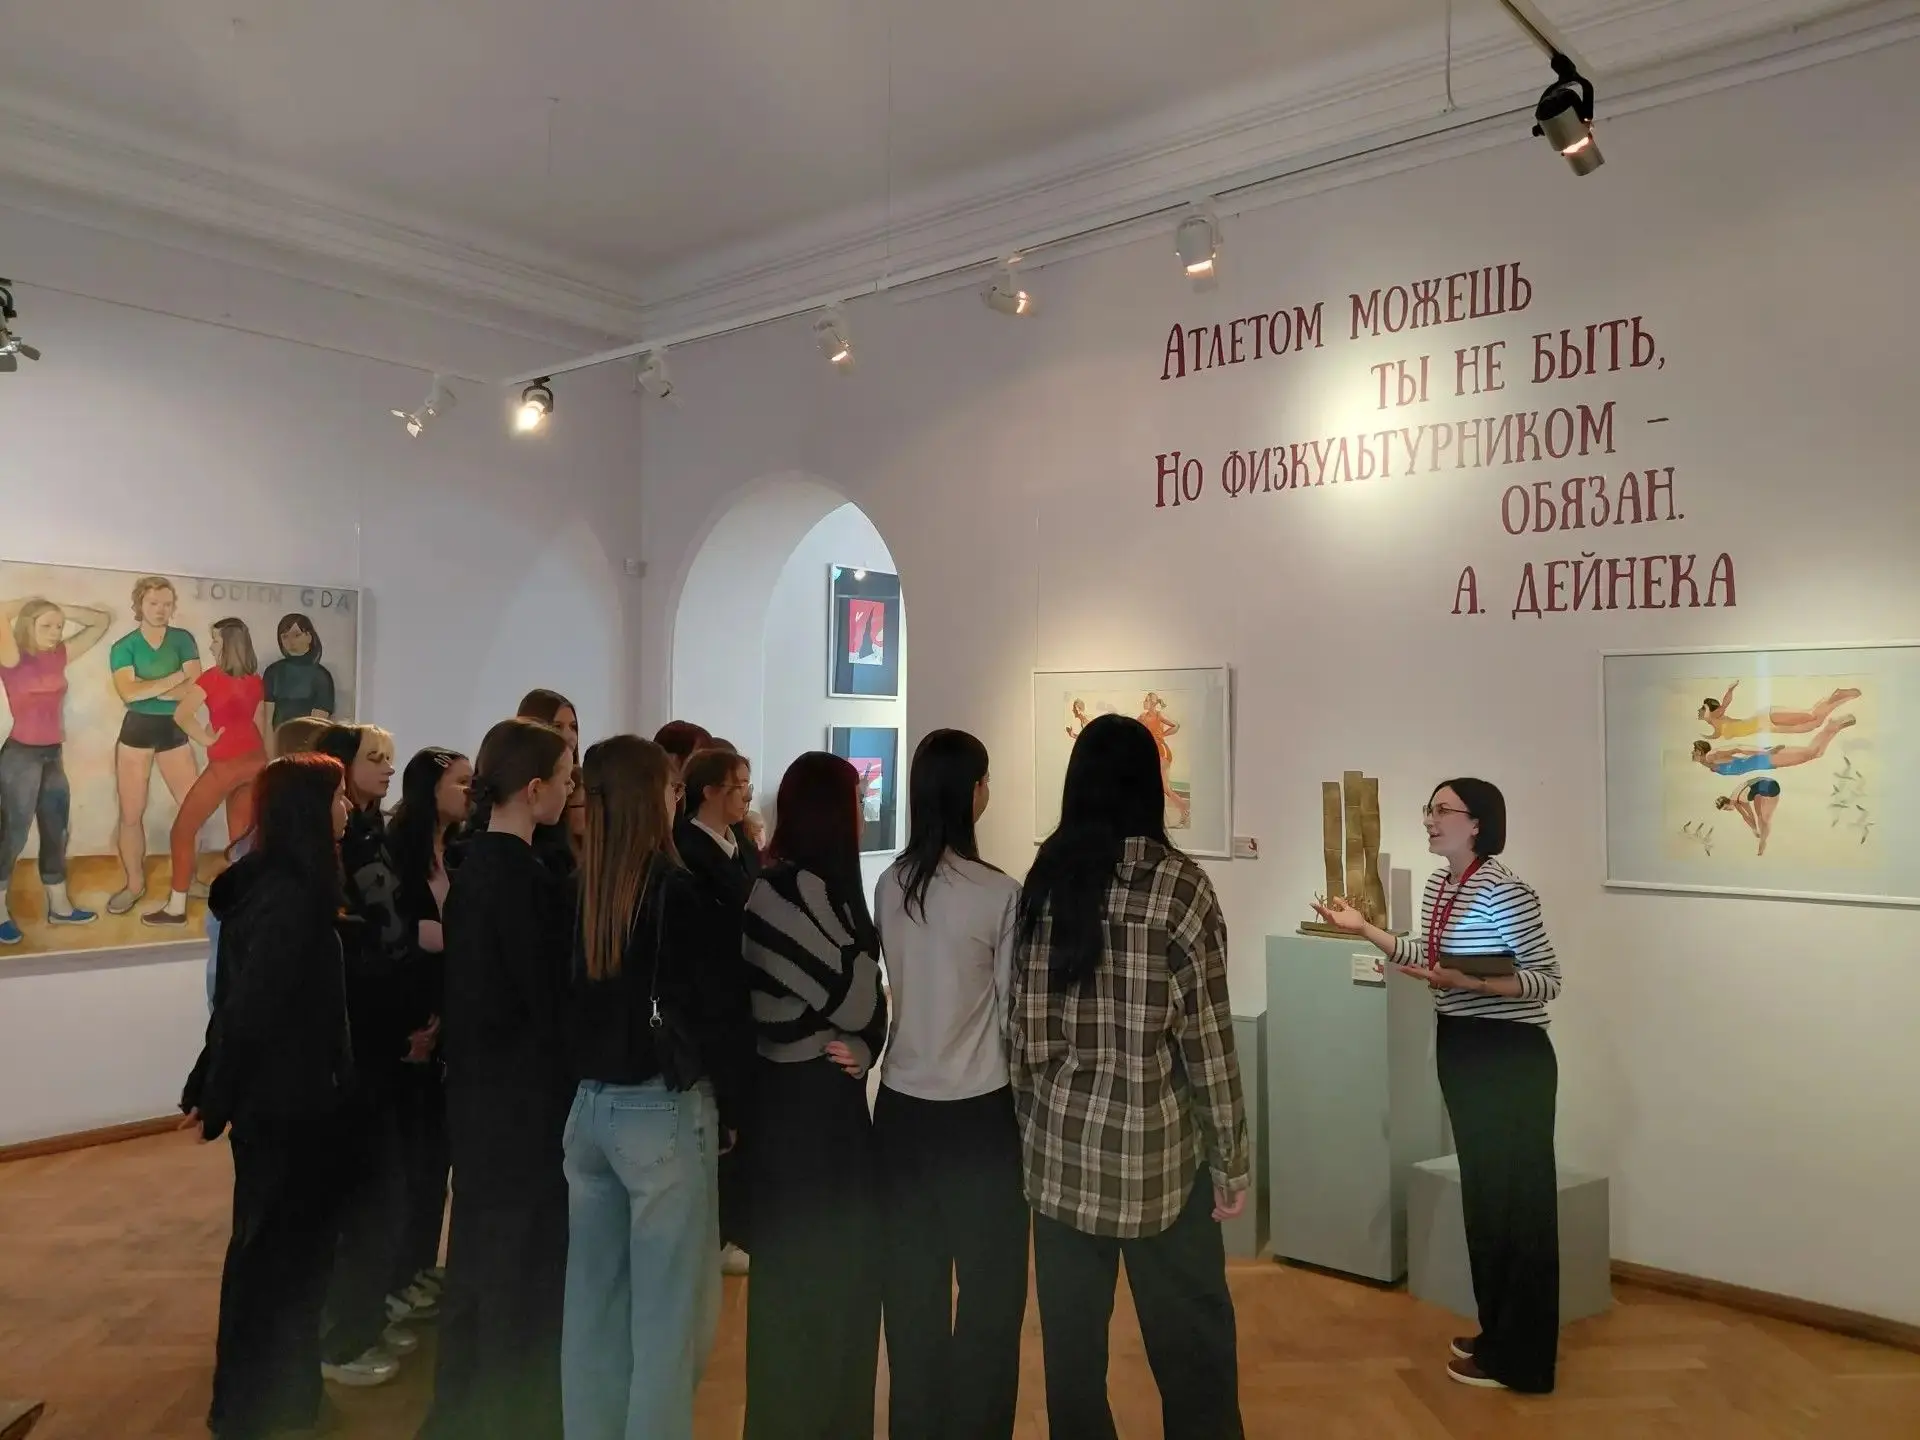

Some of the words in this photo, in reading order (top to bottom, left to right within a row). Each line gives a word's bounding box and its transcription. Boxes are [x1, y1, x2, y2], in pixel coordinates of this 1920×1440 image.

[1160, 302, 1324, 380] АТЛЕТОМ
[1349, 262, 1532, 340] МОЖЕШЬ
[1371, 355, 1430, 410] ТЫ
[1454, 341, 1506, 397] НЕ
[1531, 316, 1666, 384] БЫТЬ,
[1155, 451, 1204, 508] НО
[1221, 401, 1617, 499] ФИЗКУЛЬТУРНИКОМ
[1501, 466, 1685, 536] ОБЯЗАН.
[1451, 565, 1487, 615] А.
[1511, 551, 1737, 621] ДЕЙНЕКА
